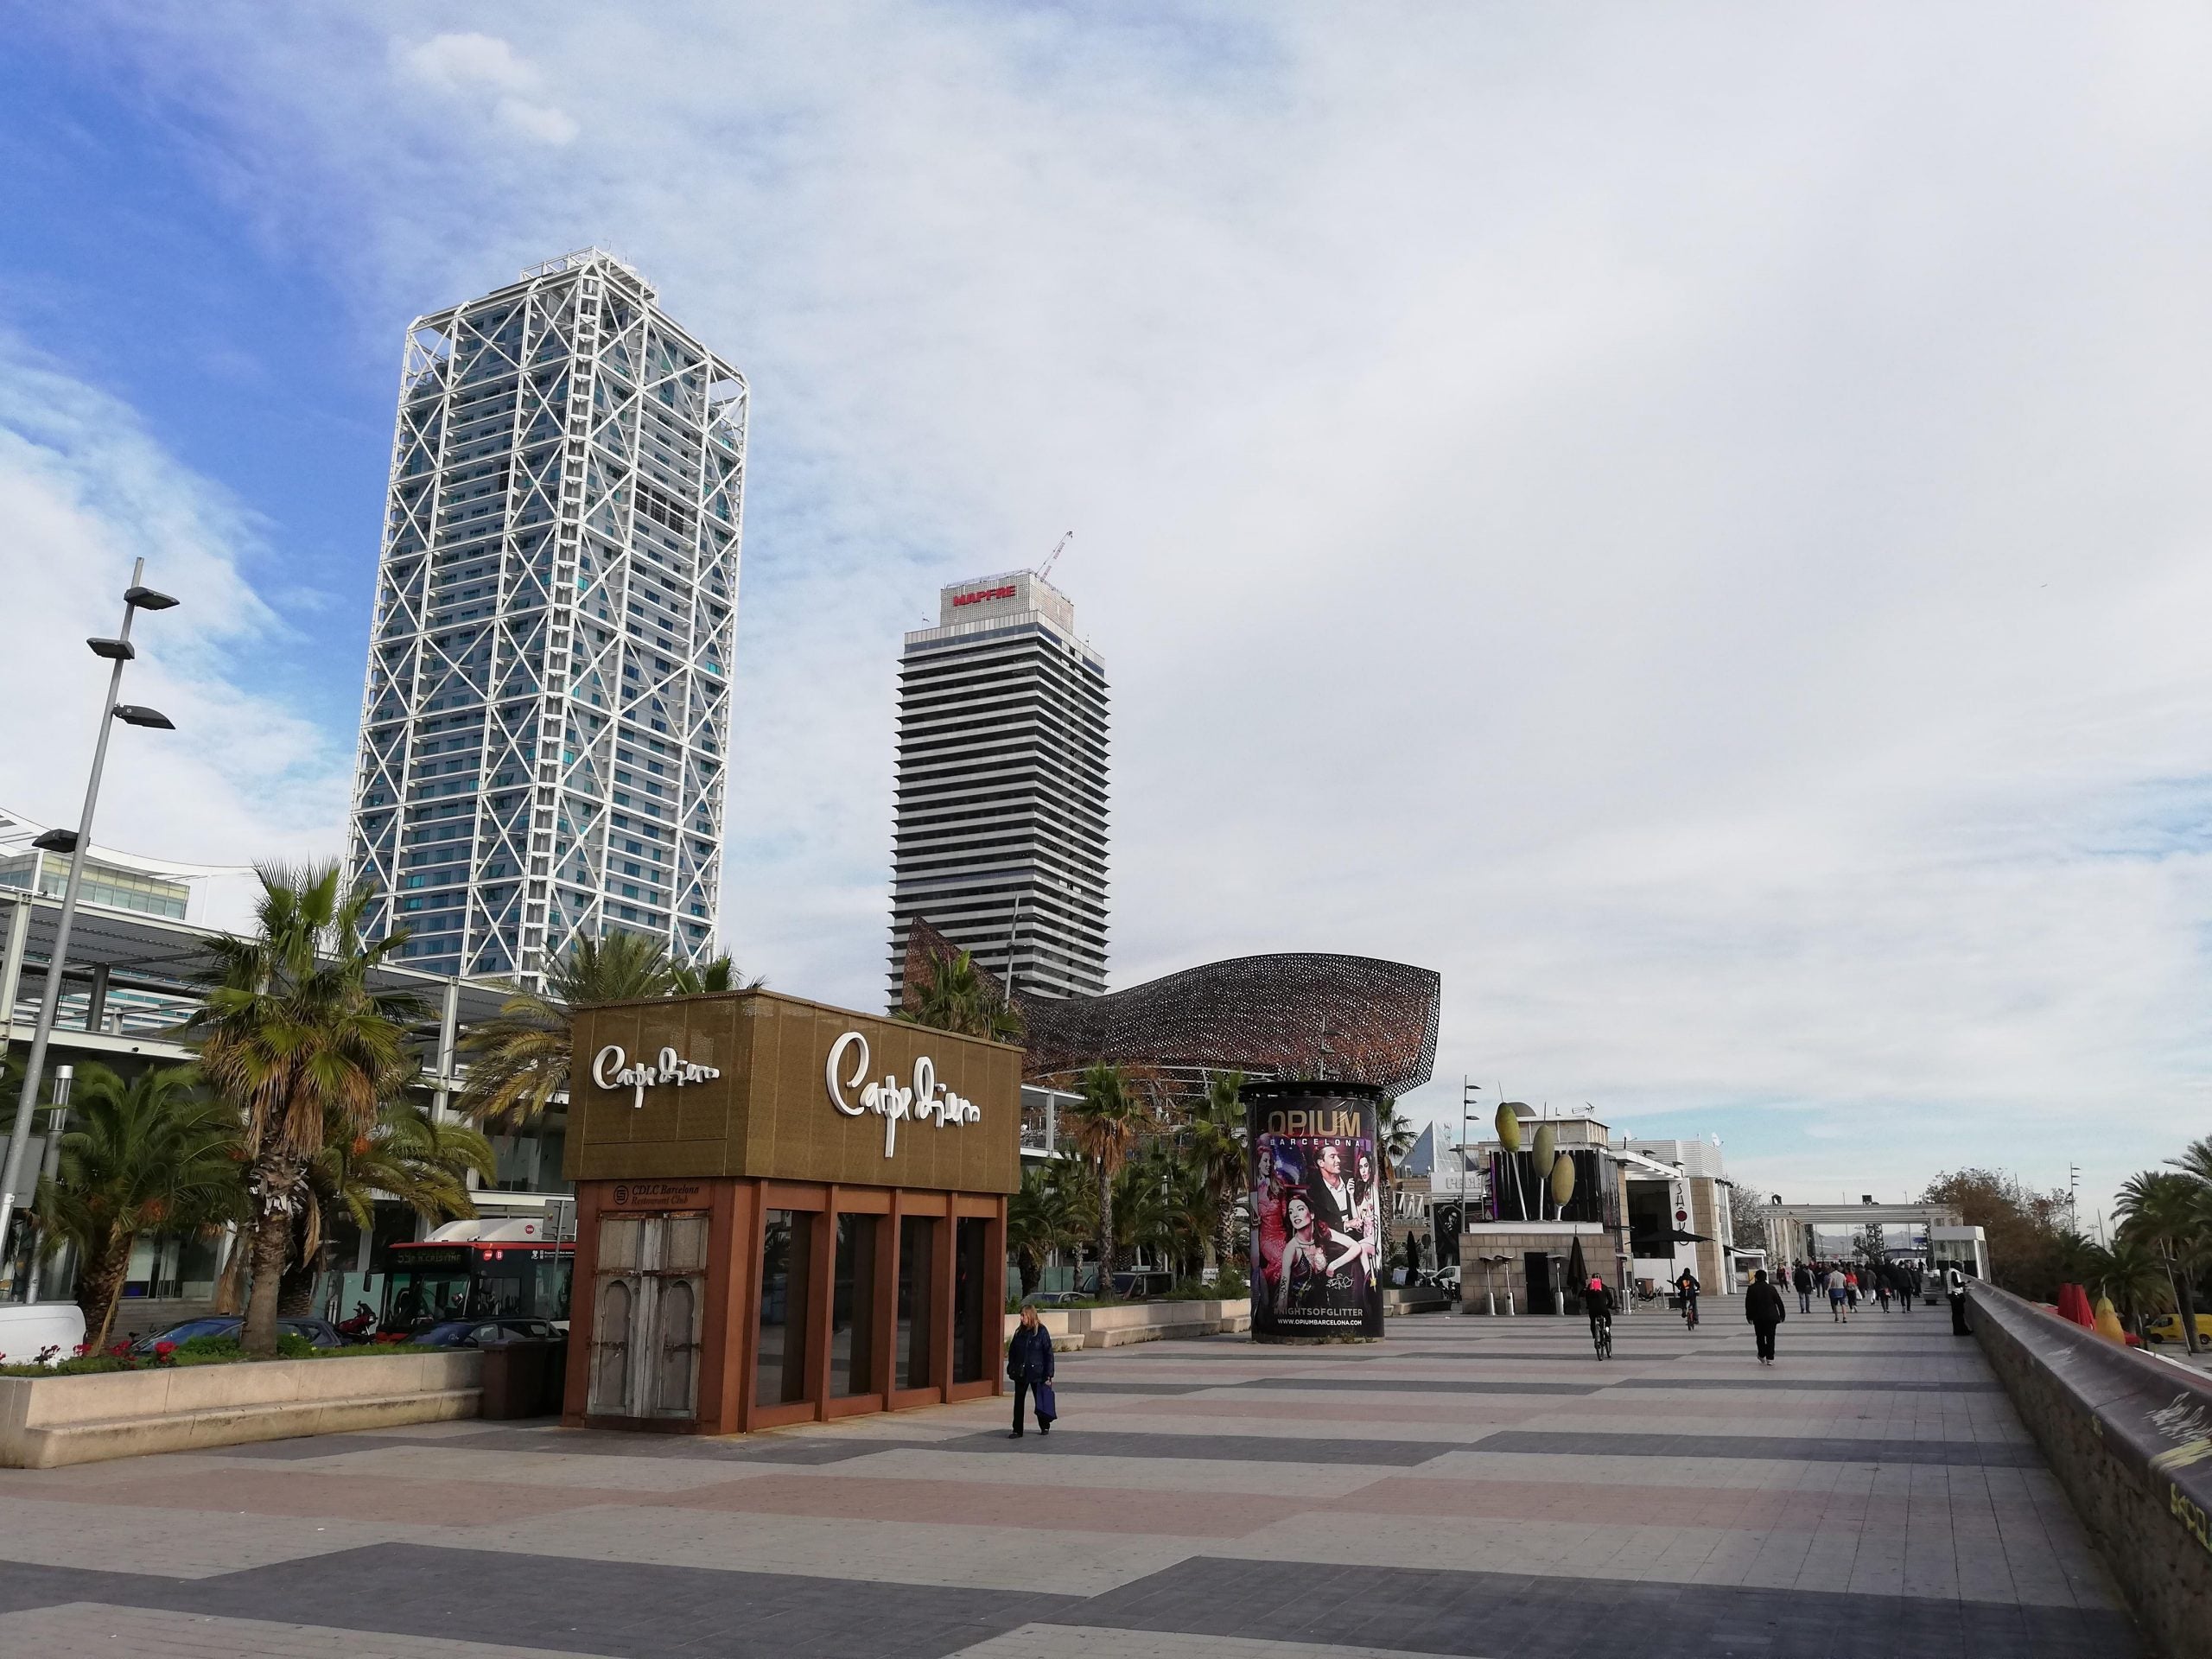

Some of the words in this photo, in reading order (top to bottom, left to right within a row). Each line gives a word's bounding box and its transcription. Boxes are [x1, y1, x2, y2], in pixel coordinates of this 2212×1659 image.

[953, 585, 1016, 607] MAPFRE
[593, 1045, 658, 1109] Carpe
[658, 1046, 721, 1087] Diem
[826, 1032, 912, 1159] Carpe
[913, 1056, 982, 1128] Diem
[1268, 1109, 1361, 1138] OPIUM
[1269, 1138, 1361, 1147] BARCELONA
[1446, 1176, 1482, 1190] PACH
[632, 1184, 659, 1196] CDLC
[660, 1184, 700, 1195] Barcelona
[671, 1195, 690, 1205] Club
[1274, 1306, 1363, 1318] #NIGHTSOFGLITTER
[1277, 1318, 1363, 1326] WWW.OPIUMBARCELONA.COM
